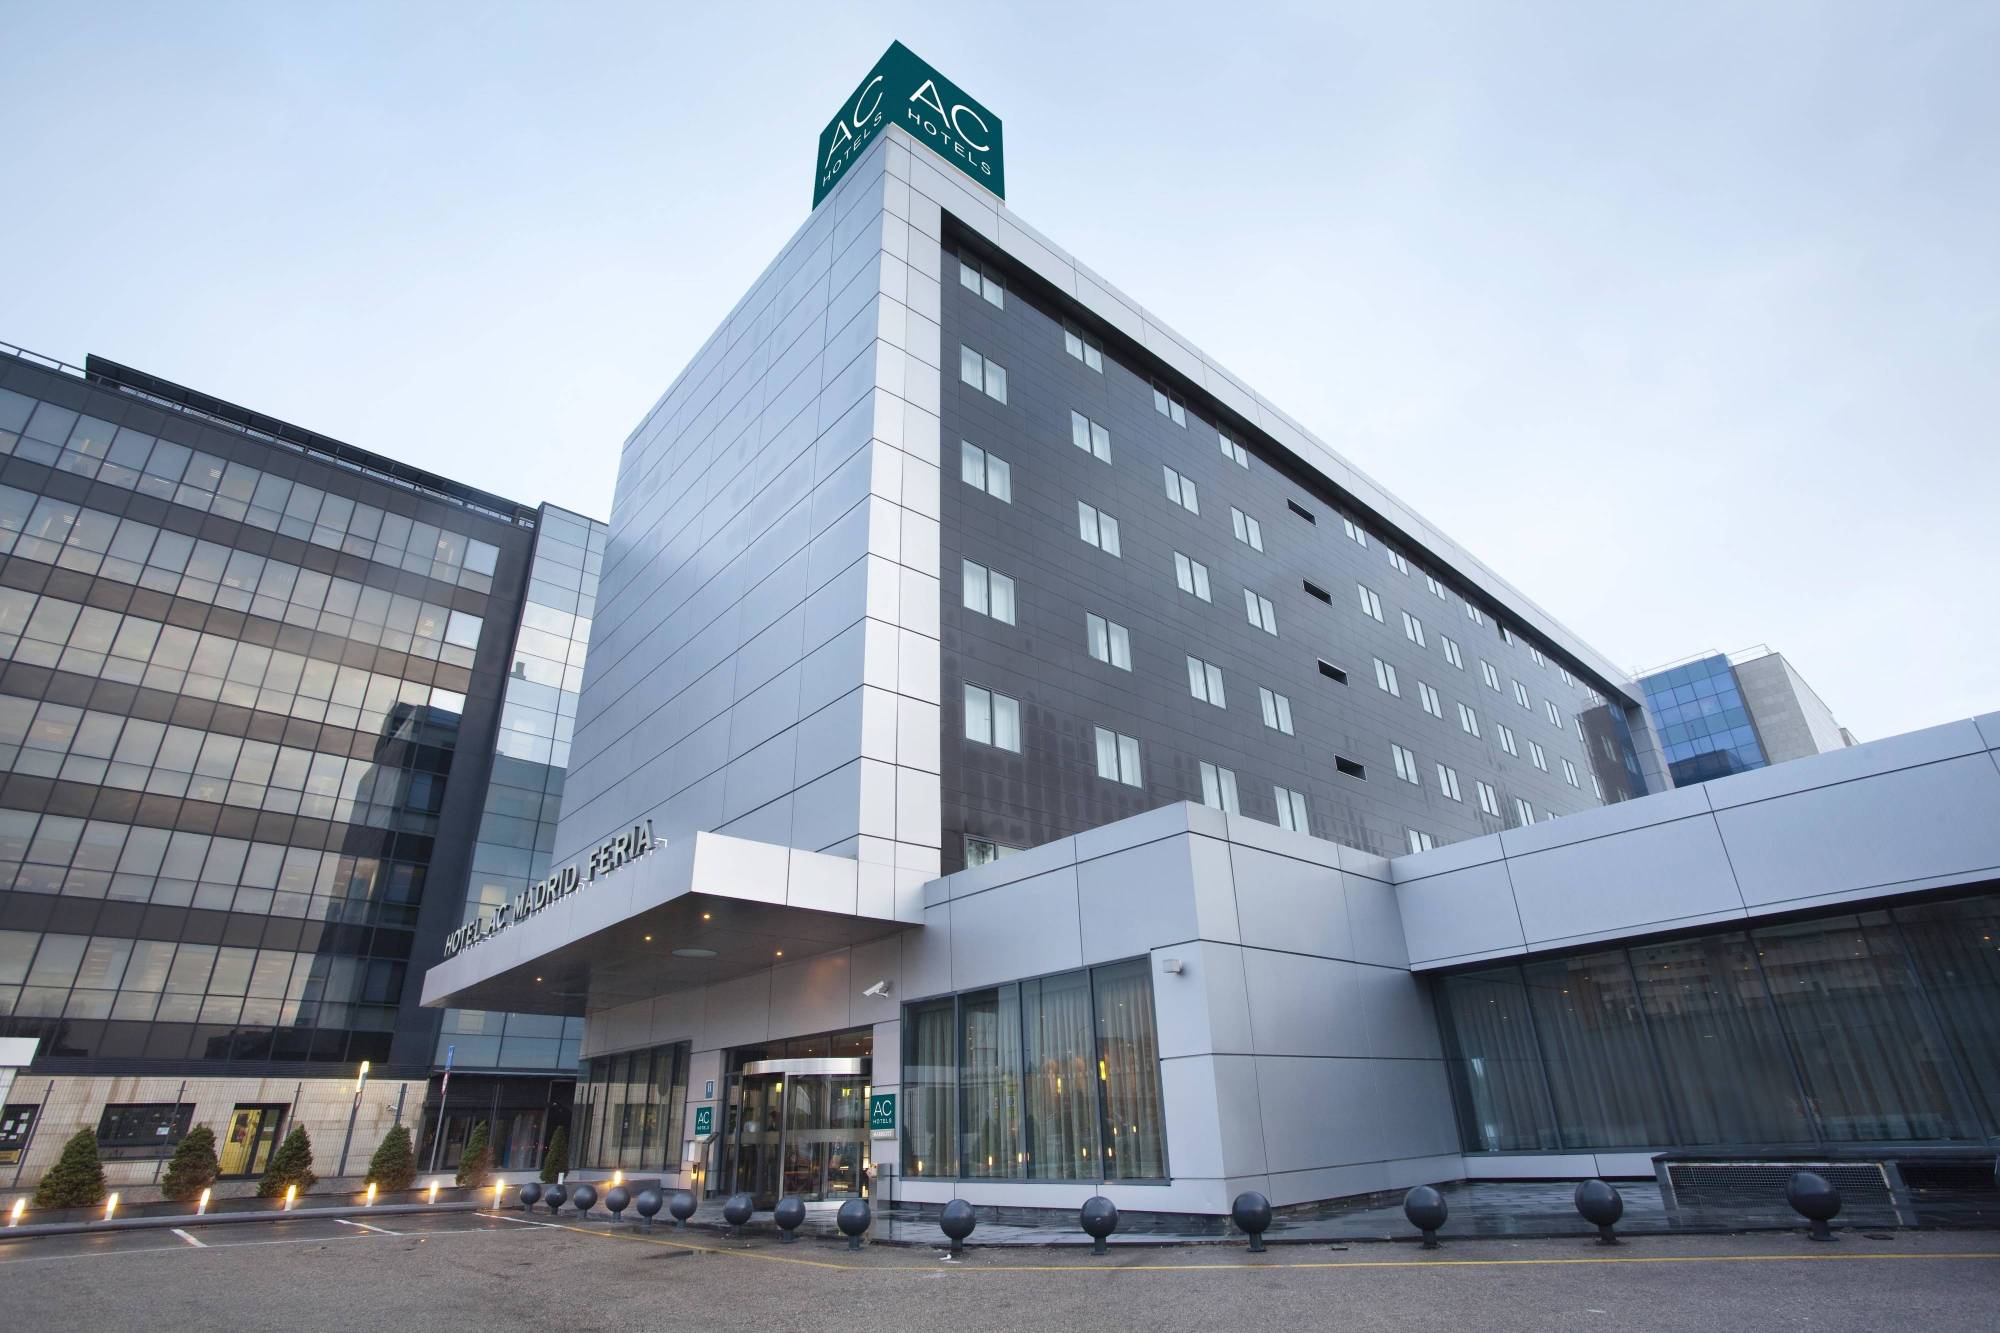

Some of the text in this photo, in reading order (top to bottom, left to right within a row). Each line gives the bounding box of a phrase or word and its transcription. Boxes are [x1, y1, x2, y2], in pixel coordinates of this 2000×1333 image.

[822, 111, 882, 187] HOTELS
[825, 75, 883, 169] AC
[908, 108, 991, 176] HOTELS
[909, 79, 990, 152] AC
[443, 819, 656, 958] HOTEL AC MADRID FERIA
[698, 1111, 710, 1125] AC
[873, 1099, 892, 1117] AC
